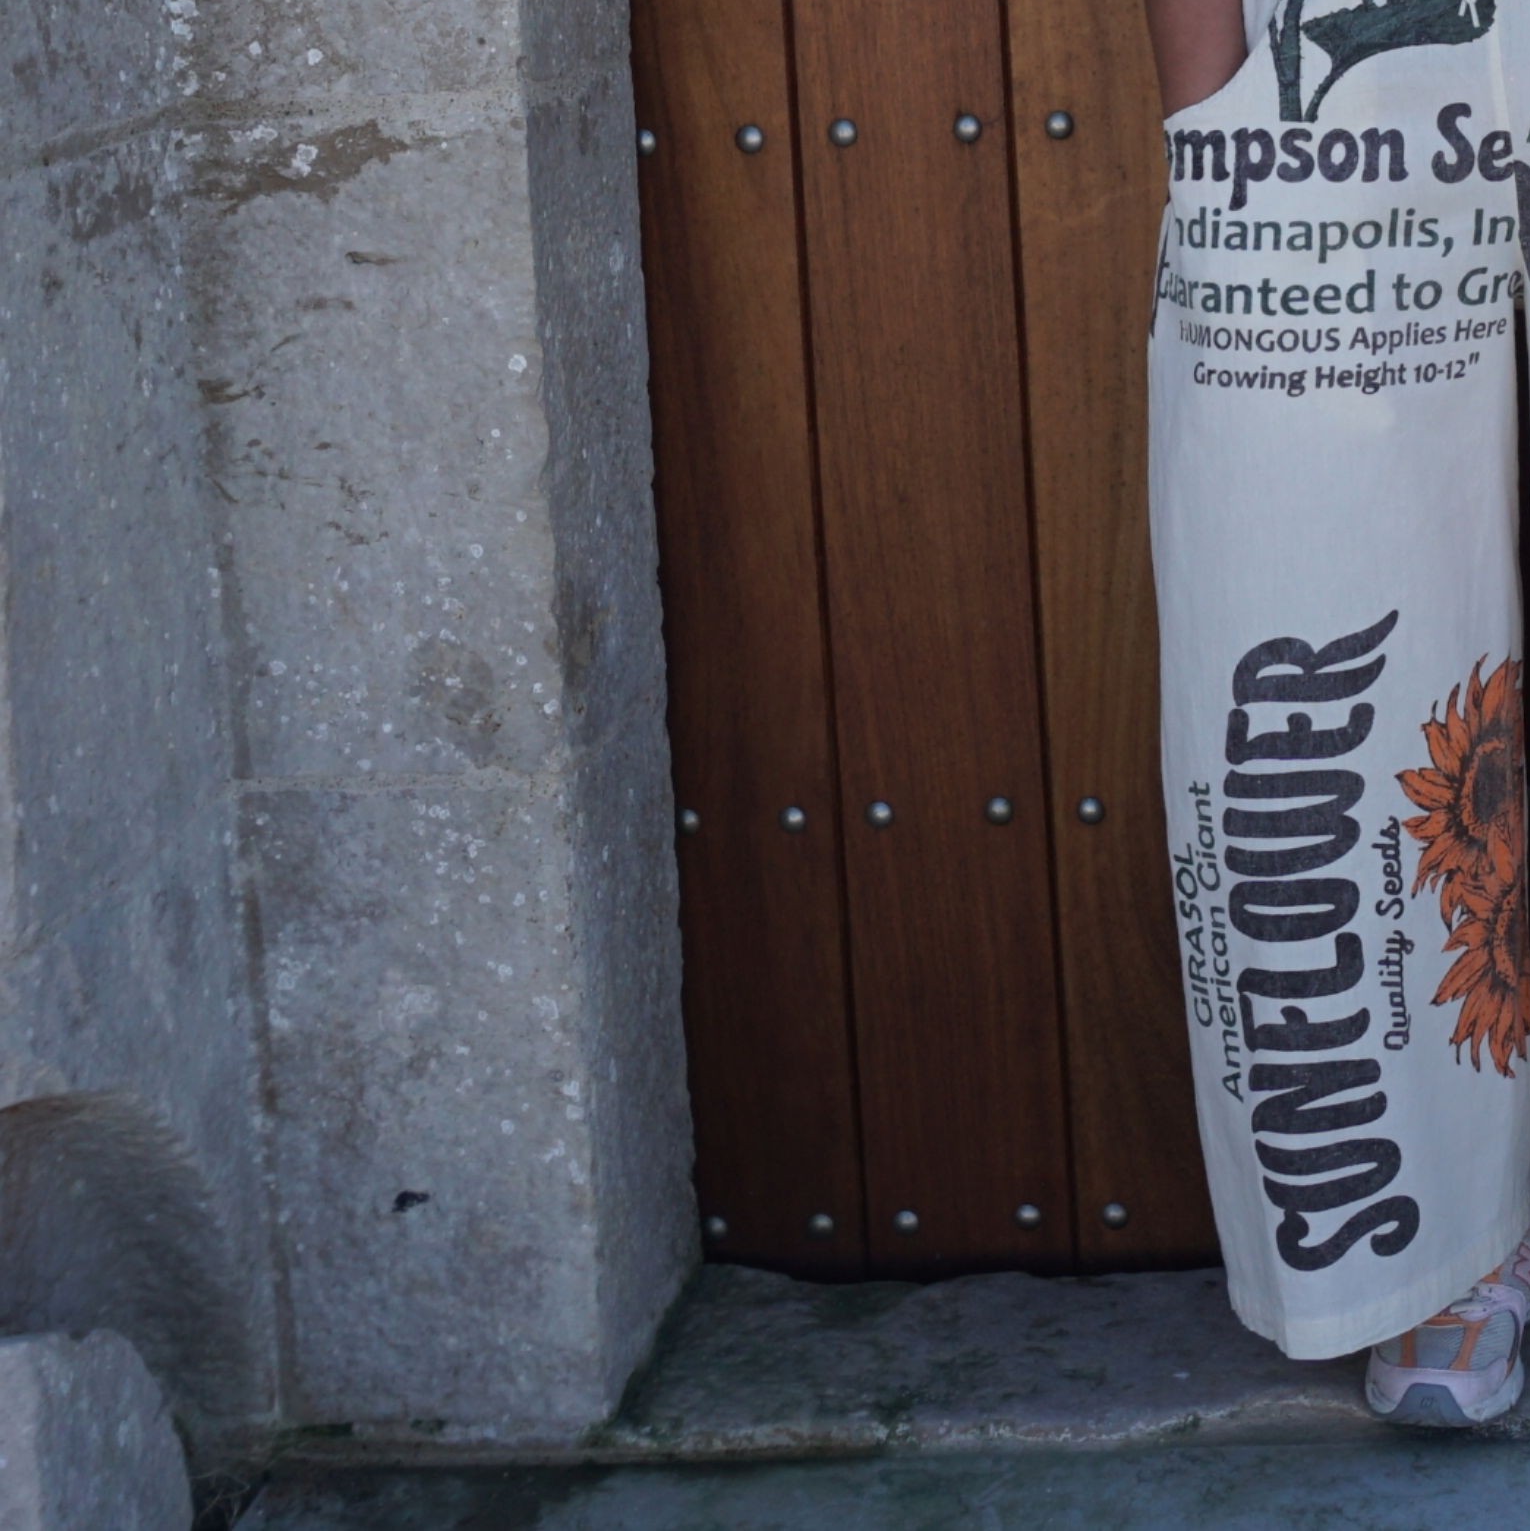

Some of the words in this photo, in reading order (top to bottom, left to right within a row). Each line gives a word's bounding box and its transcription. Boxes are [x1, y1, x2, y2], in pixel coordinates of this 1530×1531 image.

[1431, 102, 1515, 183] Se
[1472, 208, 1516, 246] In
[1179, 319, 1340, 353] HUMONGOUS
[1348, 323, 1447, 356] Applies
[1453, 316, 1507, 343] Here
[1392, 273, 1443, 311] to
[1194, 360, 1306, 397] Growing
[1315, 361, 1407, 395] Height
[1413, 352, 1480, 384] 10-12"
[1188, 780, 1221, 892] Giant
[1372, 815, 1405, 920] Seeds
[1174, 842, 1213, 1028] GIRASOL
[1222, 609, 1420, 1271] SUNFLOWER
[1210, 905, 1244, 1103] American
[1378, 929, 1415, 1051] Quality
